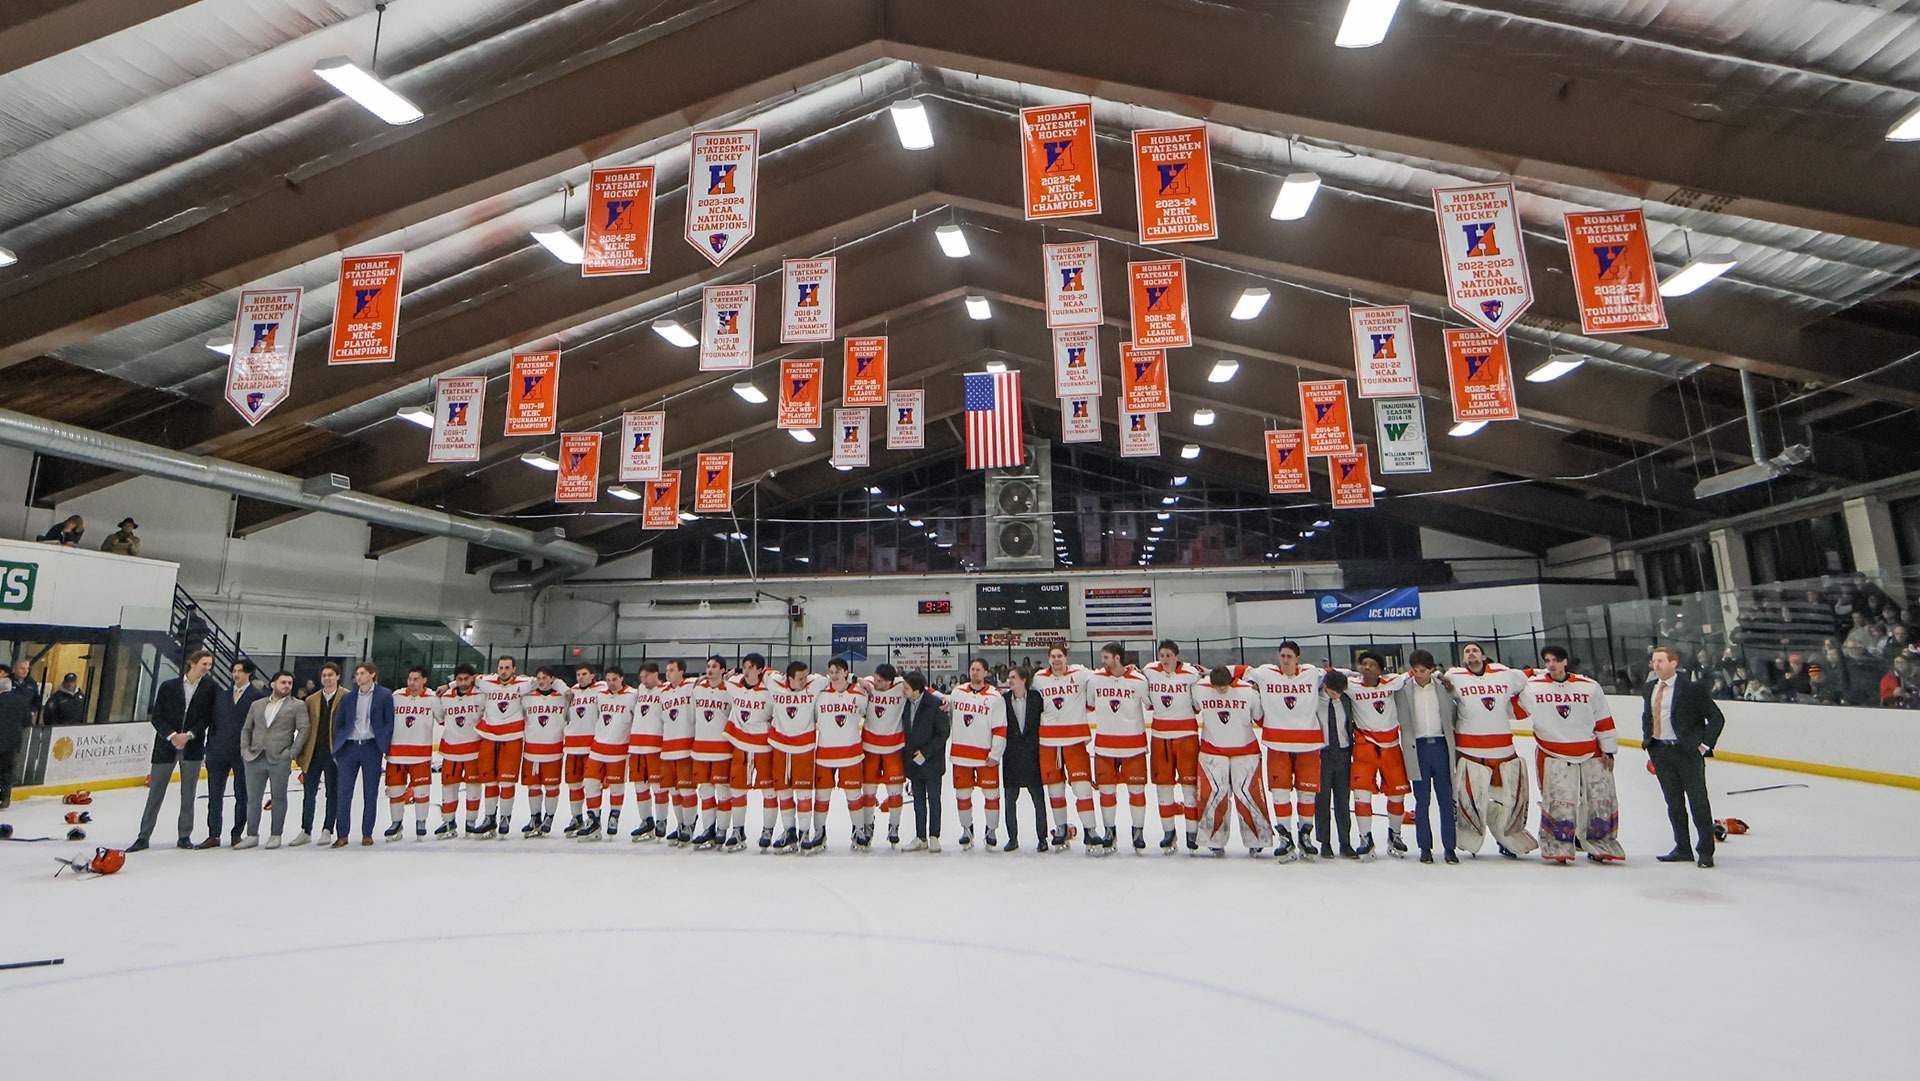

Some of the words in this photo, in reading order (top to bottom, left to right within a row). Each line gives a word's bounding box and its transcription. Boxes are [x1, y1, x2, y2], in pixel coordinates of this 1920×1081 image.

[1037, 111, 1077, 123] HOBART
[1028, 119, 1086, 131] STATESMEN
[1039, 128, 1078, 139] HOCKEY
[706, 137, 743, 145] HOBART
[1150, 134, 1192, 145] HOBART
[697, 144, 751, 154] STATESMEN
[1141, 142, 1201, 154] STATESMEN
[705, 153, 742, 162] HOCKEY
[1152, 151, 1193, 162] HOCKEY
[605, 173, 641, 182] HOBART
[1041, 175, 1081, 186] 2023-24
[595, 181, 648, 191] STATESMEN
[1048, 184, 1075, 193] NEHC
[603, 189, 639, 198] HOCKEY
[1040, 192, 1085, 202] PLAYOFF
[1453, 192, 1496, 203] HOBART
[698, 198, 745, 207] 2023-2024
[1032, 199, 1093, 212] CHAMPIONS
[1155, 198, 1197, 208] 2023-24
[1444, 200, 1508, 213] STATESMEN
[708, 206, 733, 214] NCAA
[1163, 207, 1190, 216] NEHC
[697, 215, 744, 223] NATIONAL
[1157, 215, 1198, 225] LEAGUE
[1456, 210, 1499, 221] HOCKEY
[1583, 214, 1625, 224] HOBART
[692, 222, 748, 231] CHAMPIONS
[1147, 223, 1210, 236] CHAMPIONS
[1575, 222, 1637, 235] STATESMEN
[599, 234, 636, 243] 2024-25
[1587, 234, 1630, 244] HOCKEY
[599, 250, 634, 258] LEAGUE
[1057, 246, 1085, 254] HOBART
[1051, 252, 1092, 260] STATESMEN
[354, 261, 389, 270] HOBART
[588, 258, 643, 268] CHAMPIONS
[1457, 259, 1515, 271] 2022-2023
[345, 269, 396, 279] STATESMEN
[790, 268, 828, 276] STATESMEN
[1136, 271, 1178, 279] STATESMEN
[1472, 269, 1502, 278] NCAA
[352, 277, 388, 287] HOCKEY
[1143, 278, 1173, 286] HOCKEY
[1461, 277, 1517, 289] NATIONAL
[1457, 285, 1524, 298] CHAMPIONS
[1594, 284, 1641, 295] 2022-23
[254, 295, 288, 304] HOBART
[1058, 293, 1088, 301] 2019-20
[244, 304, 294, 313] STATESMEN
[1052, 307, 1098, 315] TOURNAMENT
[1585, 303, 1658, 316] TOURNAMENT
[251, 312, 285, 320] HOCKEY
[1144, 314, 1177, 322] 2021-22
[1592, 313, 1653, 325] CHAMPIONS
[348, 322, 383, 332] 2024-25
[1359, 318, 1404, 326] STATESMEN
[352, 331, 376, 339] NEHC
[1139, 336, 1184, 344] CHAMPIONS
[344, 339, 383, 348] PLAYOFF
[1452, 339, 1499, 348] STATESMEN
[335, 347, 388, 357] CHAMPIONS
[1461, 346, 1492, 354] HOCKEY
[1363, 376, 1412, 384] TOURNAMENT
[1464, 384, 1500, 392] 2022-23
[1471, 392, 1496, 400] NEHC
[519, 402, 544, 410] 2017-18
[1461, 408, 1510, 416] CHAMPIONS
[1368, 608, 1382, 618] ICE
[1384, 607, 1417, 617] HOCKEY
[1148, 683, 1188, 693] HOBART
[1267, 684, 1312, 694] HOBART
[1460, 684, 1509, 697] HOBART
[773, 695, 814, 704] HOBART
[1535, 693, 1590, 704] HOBART
[820, 703, 858, 714] HOBART
[1202, 699, 1247, 710] HOBART
[394, 705, 432, 716] HOBART
[77, 735, 106, 746] BANK
[75, 746, 115, 759] FINGER
[119, 744, 148, 754] LAKES
